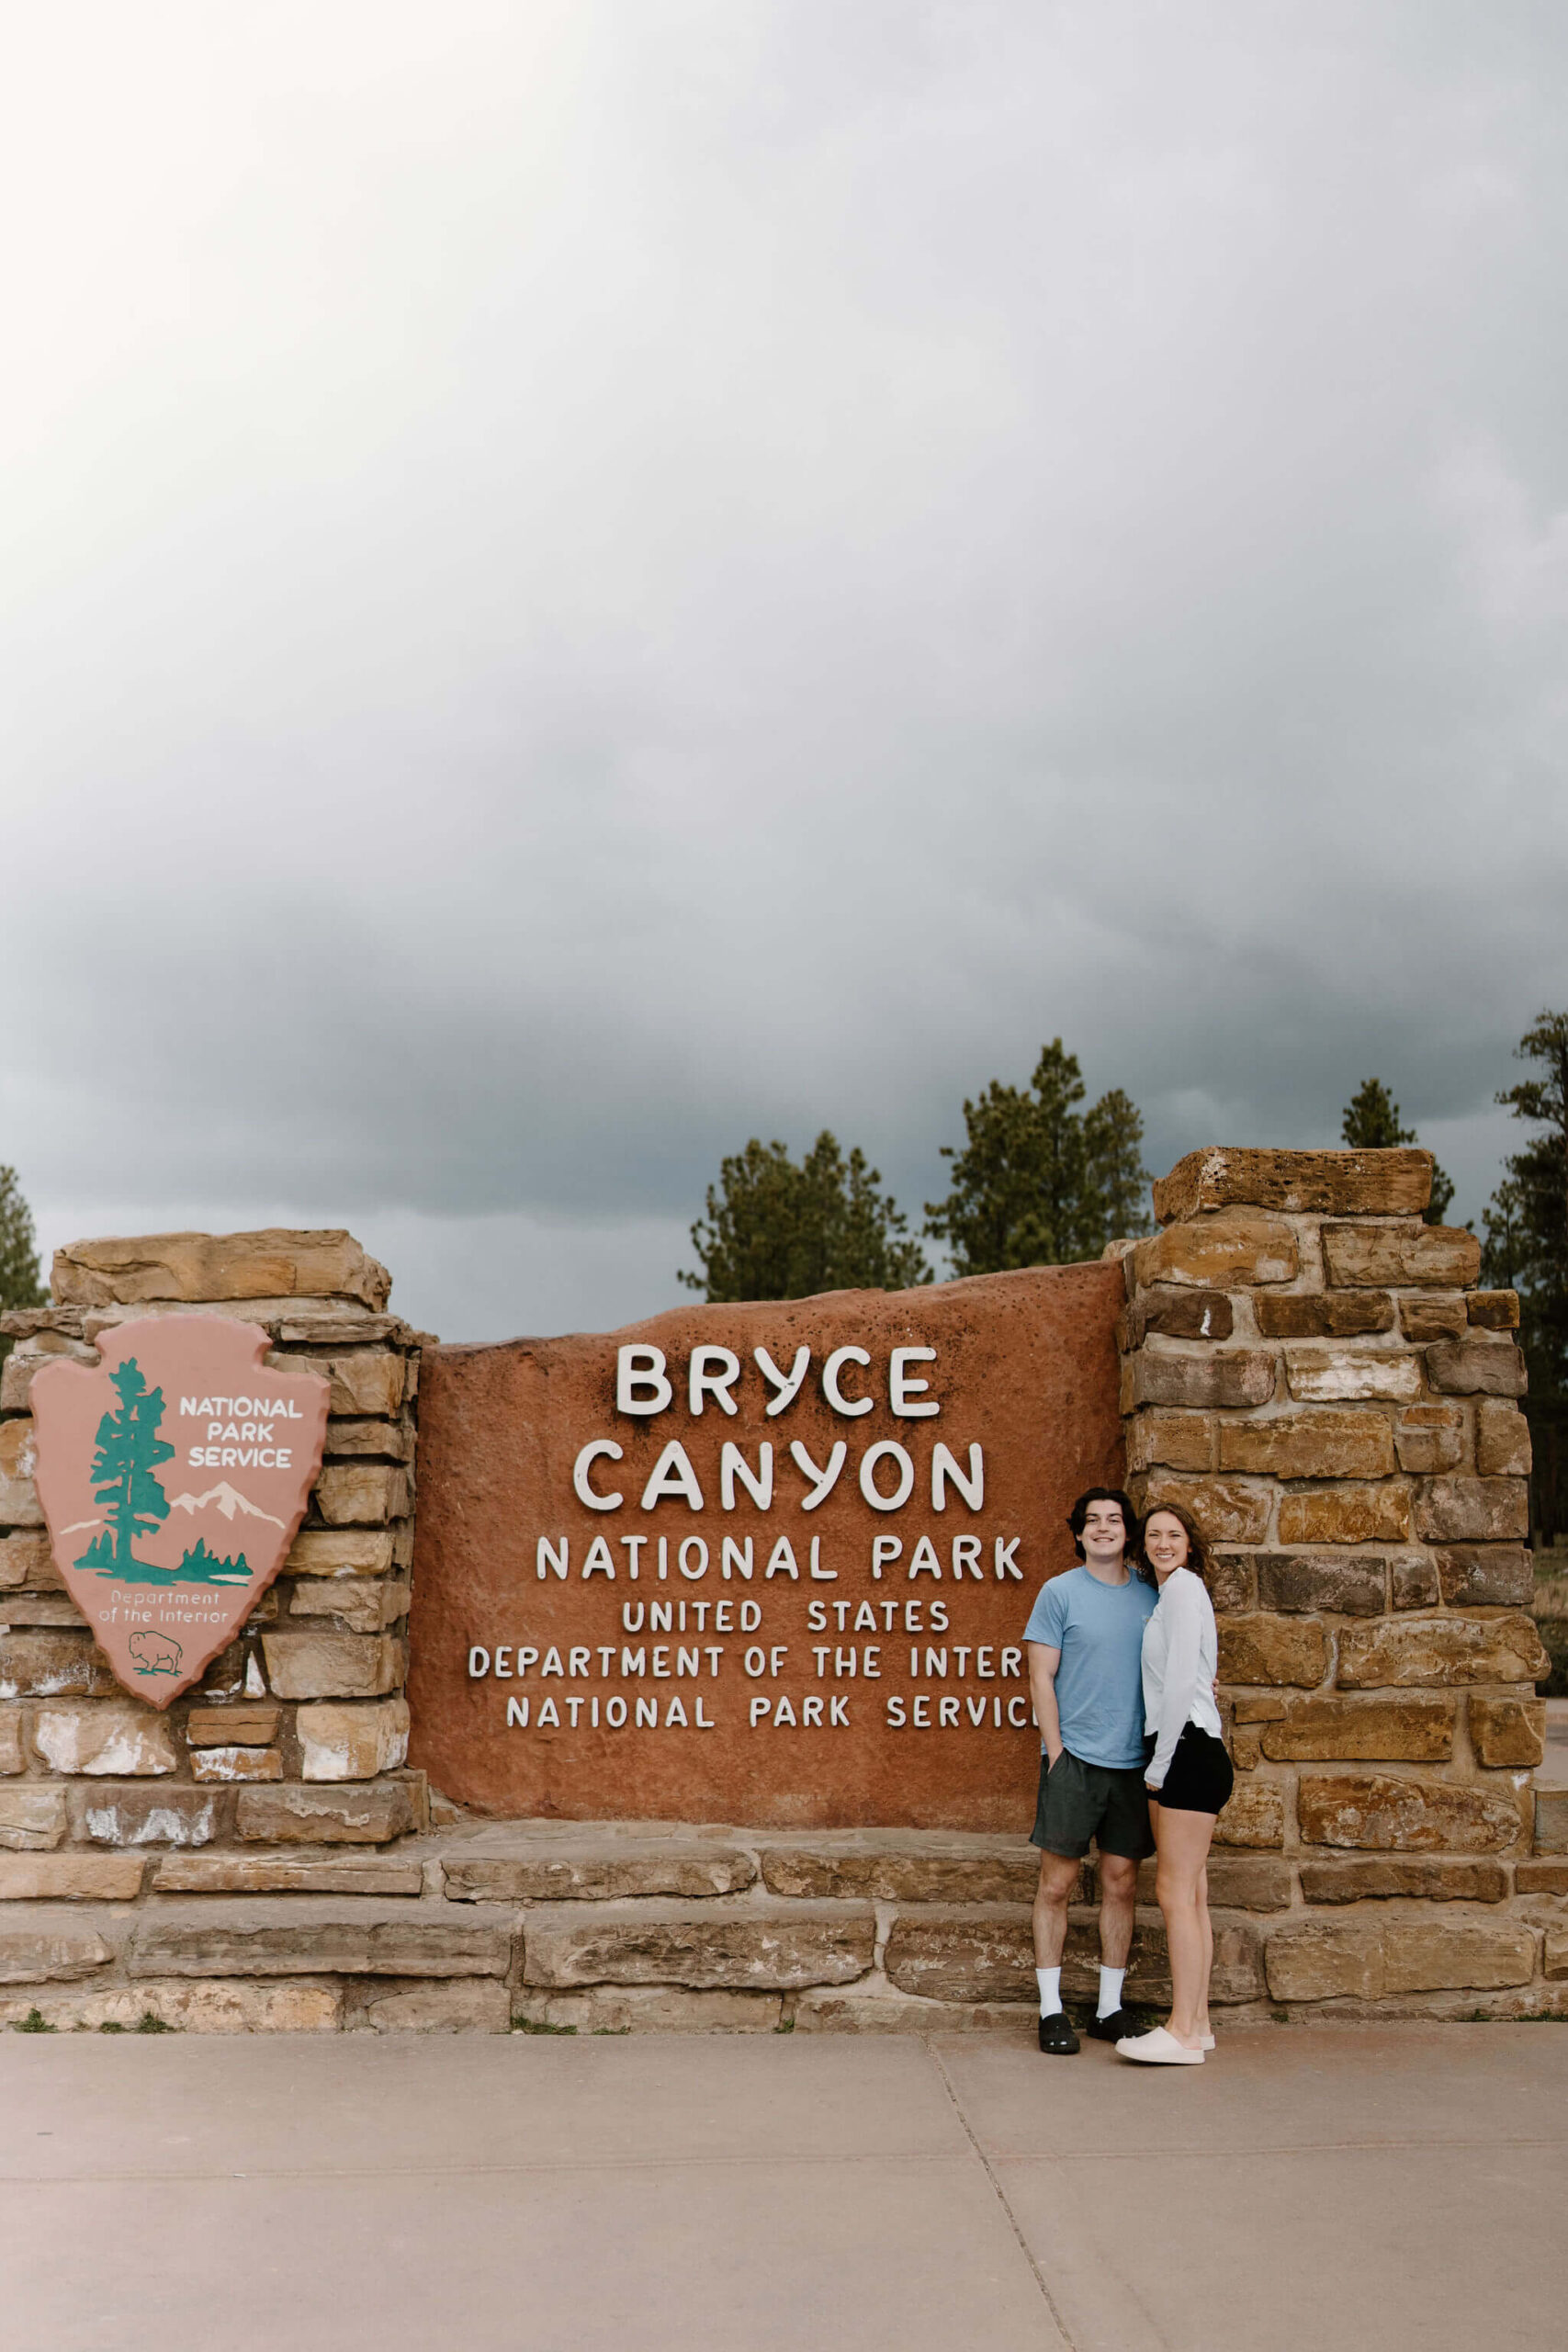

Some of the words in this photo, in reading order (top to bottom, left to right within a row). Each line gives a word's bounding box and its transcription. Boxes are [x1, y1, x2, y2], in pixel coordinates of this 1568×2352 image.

[616, 1343, 940, 1417] BRYCE
[179, 1396, 303, 1419] NATIONAL
[208, 1421, 275, 1442] PARK
[188, 1446, 292, 1468] SERVICE
[573, 1439, 984, 1511] CANYON
[536, 1535, 839, 1580] NATIONAL
[873, 1534, 1023, 1580] PARK
[111, 1590, 220, 1607] Department
[98, 1608, 118, 1623] of
[124, 1609, 152, 1623] the
[160, 1609, 229, 1623] Interior
[623, 1600, 761, 1632] UNITED
[807, 1600, 949, 1632] STATES
[468, 1645, 724, 1678] DEPARTMENT
[744, 1645, 788, 1678] OF
[812, 1645, 881, 1678] THE
[911, 1645, 1022, 1678] INTER
[506, 1696, 715, 1728] NATIONAL
[750, 1695, 850, 1727] PARK
[886, 1695, 1039, 1727] SERVIC
